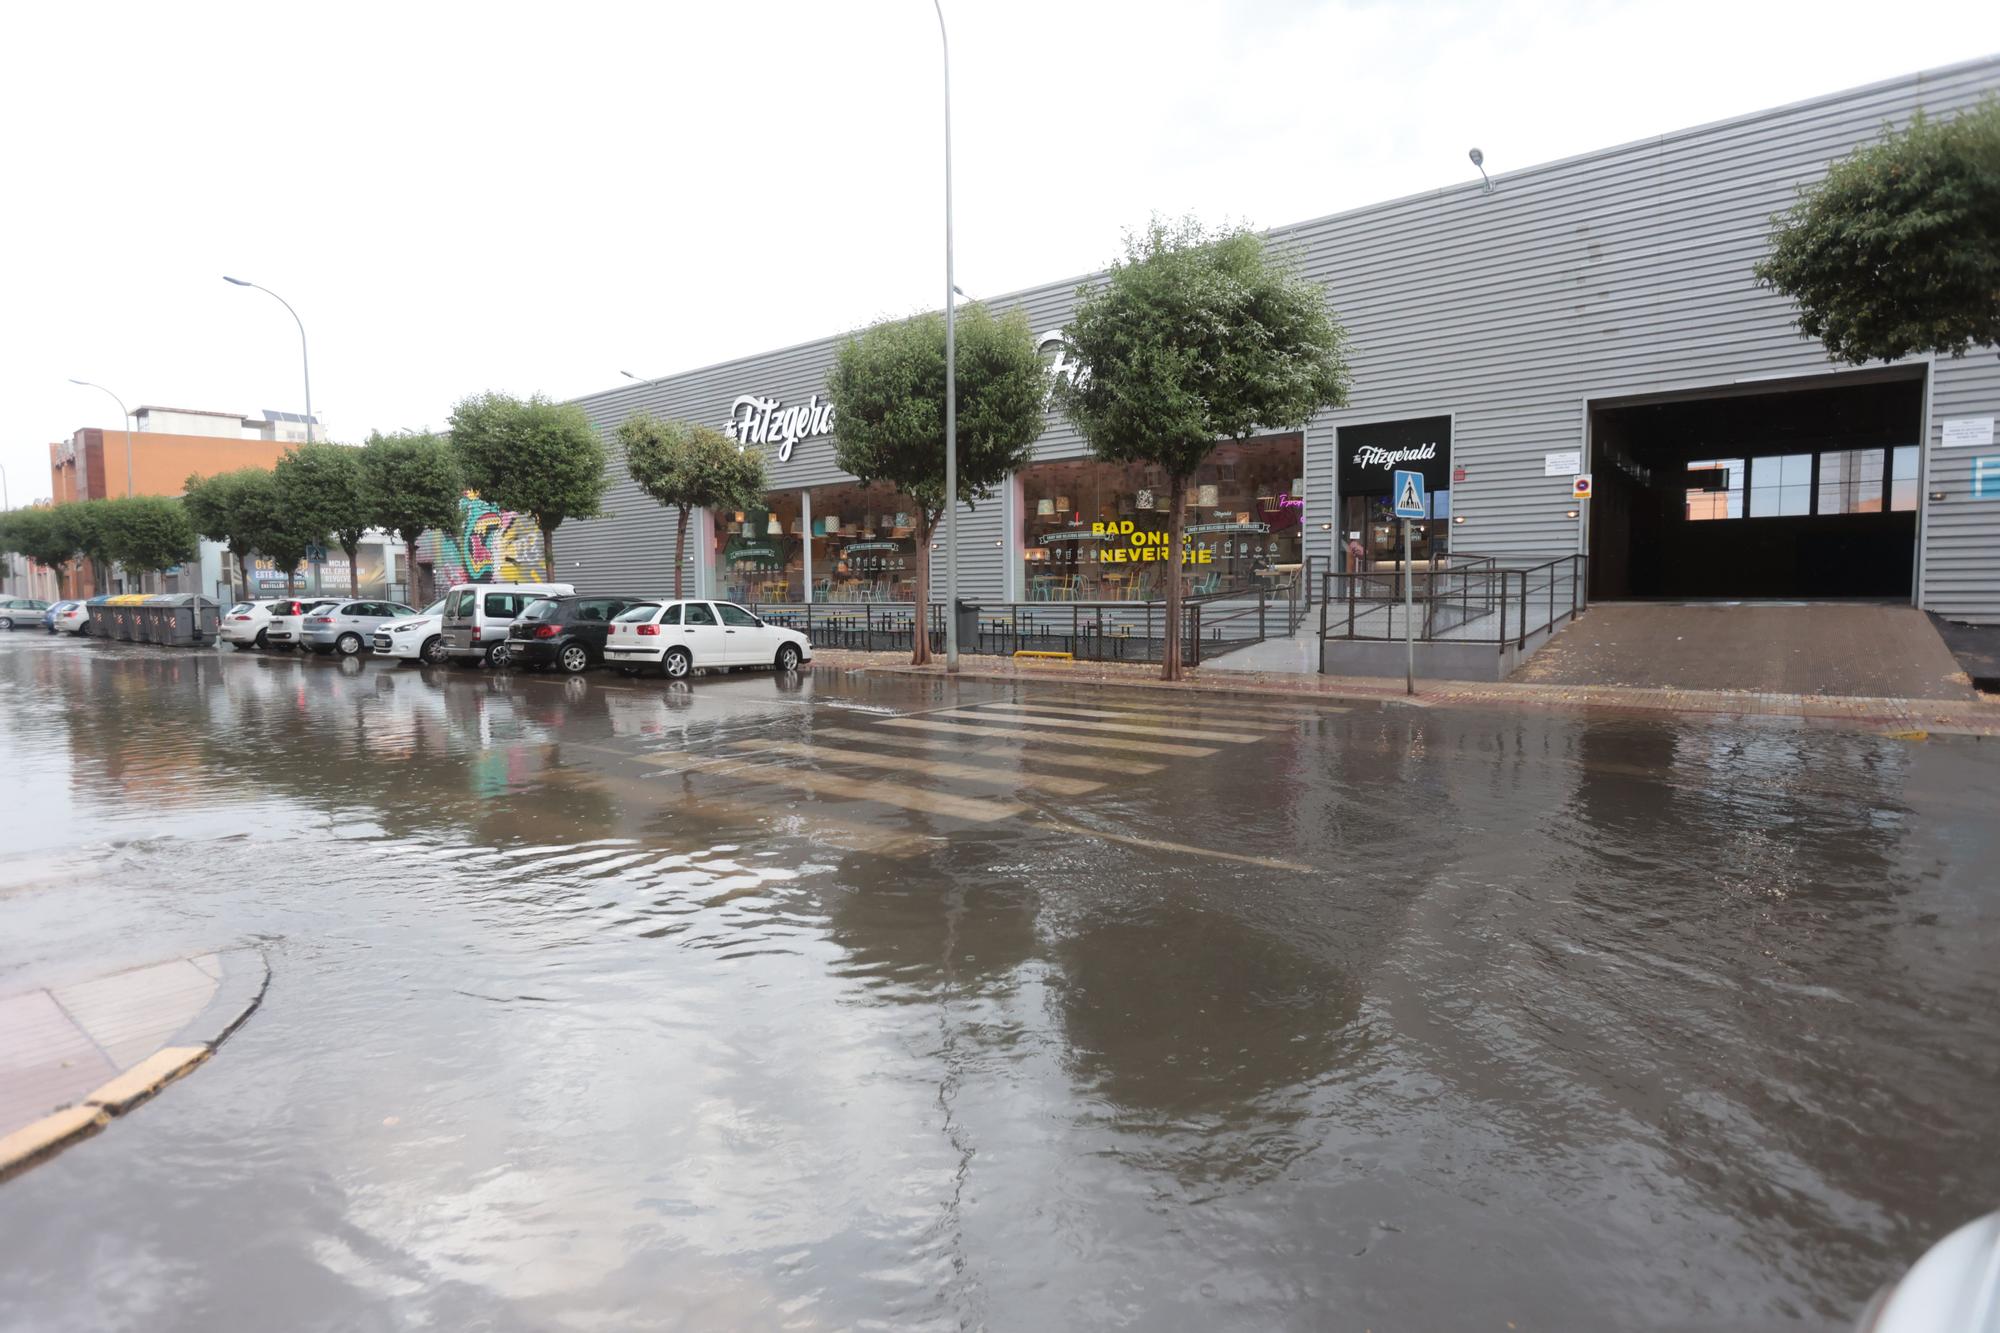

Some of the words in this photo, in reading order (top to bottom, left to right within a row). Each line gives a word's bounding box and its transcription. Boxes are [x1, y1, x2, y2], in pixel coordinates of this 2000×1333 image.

[1358, 442, 1436, 471] Fitzgerald
[1092, 521, 1134, 536] BAD
[1100, 547, 1169, 563] NEVER
